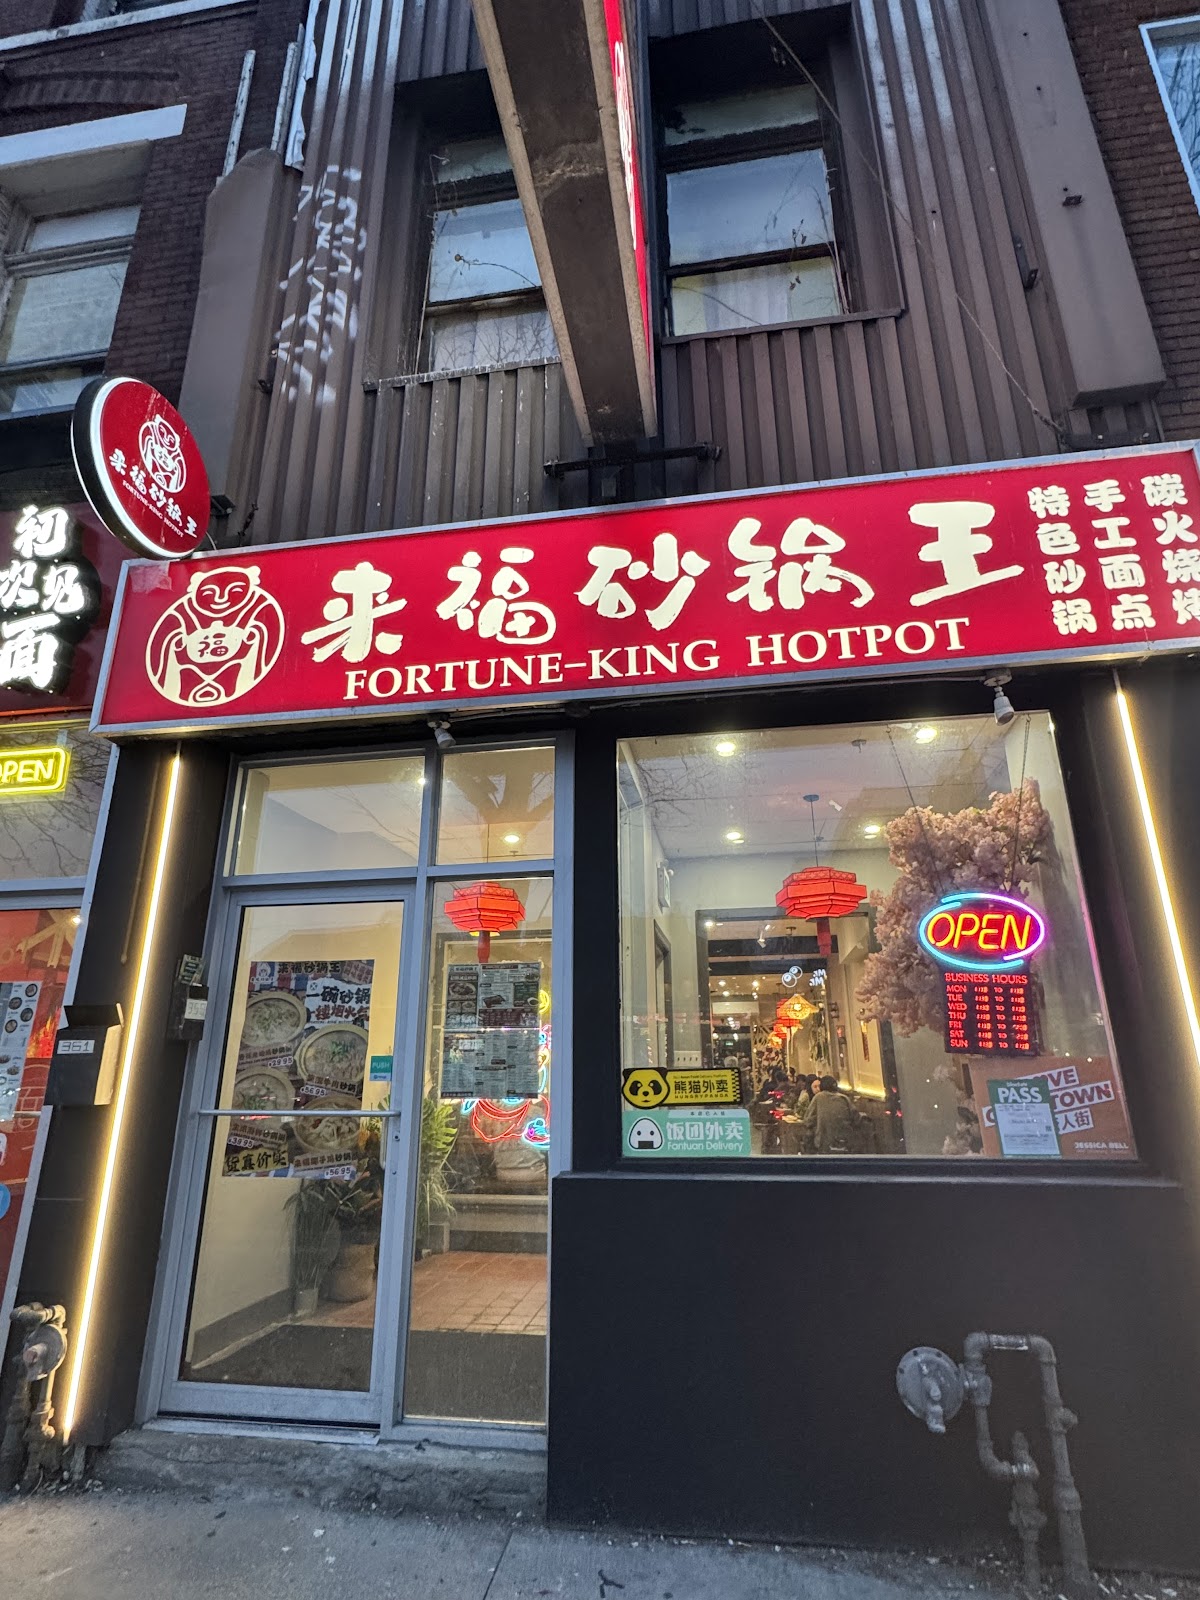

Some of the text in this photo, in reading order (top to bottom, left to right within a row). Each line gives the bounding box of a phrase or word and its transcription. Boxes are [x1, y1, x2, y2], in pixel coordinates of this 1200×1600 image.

[109, 448, 197, 538] 来福砂锅王
[122, 480, 184, 538] FORTUNE-KING HOTPOT
[1083, 479, 1156, 631] 手工面点
[1141, 473, 1200, 625] 碳火烧烤
[1027, 485, 1097, 635] 特色砂锅
[301, 501, 1024, 663] 来福砂锅王
[343, 617, 970, 700] FORTUNE-KING HOTPOT
[0, 759, 54, 783] PEN
[927, 913, 1031, 950] OPEN
[945, 973, 1028, 985] BUSINESS HOURS
[946, 985, 967, 993] MON
[947, 993, 963, 1002] TUE
[948, 1002, 967, 1011] WED
[948, 1011, 966, 1020] THU
[949, 1021, 962, 1029] FRI
[949, 1029, 964, 1038] SAT
[950, 1039, 968, 1048] SUN
[372, 1061, 390, 1069] PUSH
[674, 1080, 729, 1094] 熊猫外卖
[998, 1087, 1042, 1103] PASS
[1056, 1110, 1090, 1130] 人街
[666, 1122, 743, 1140] 饭团外卖
[668, 1141, 743, 1153] Fantuan Delivery
